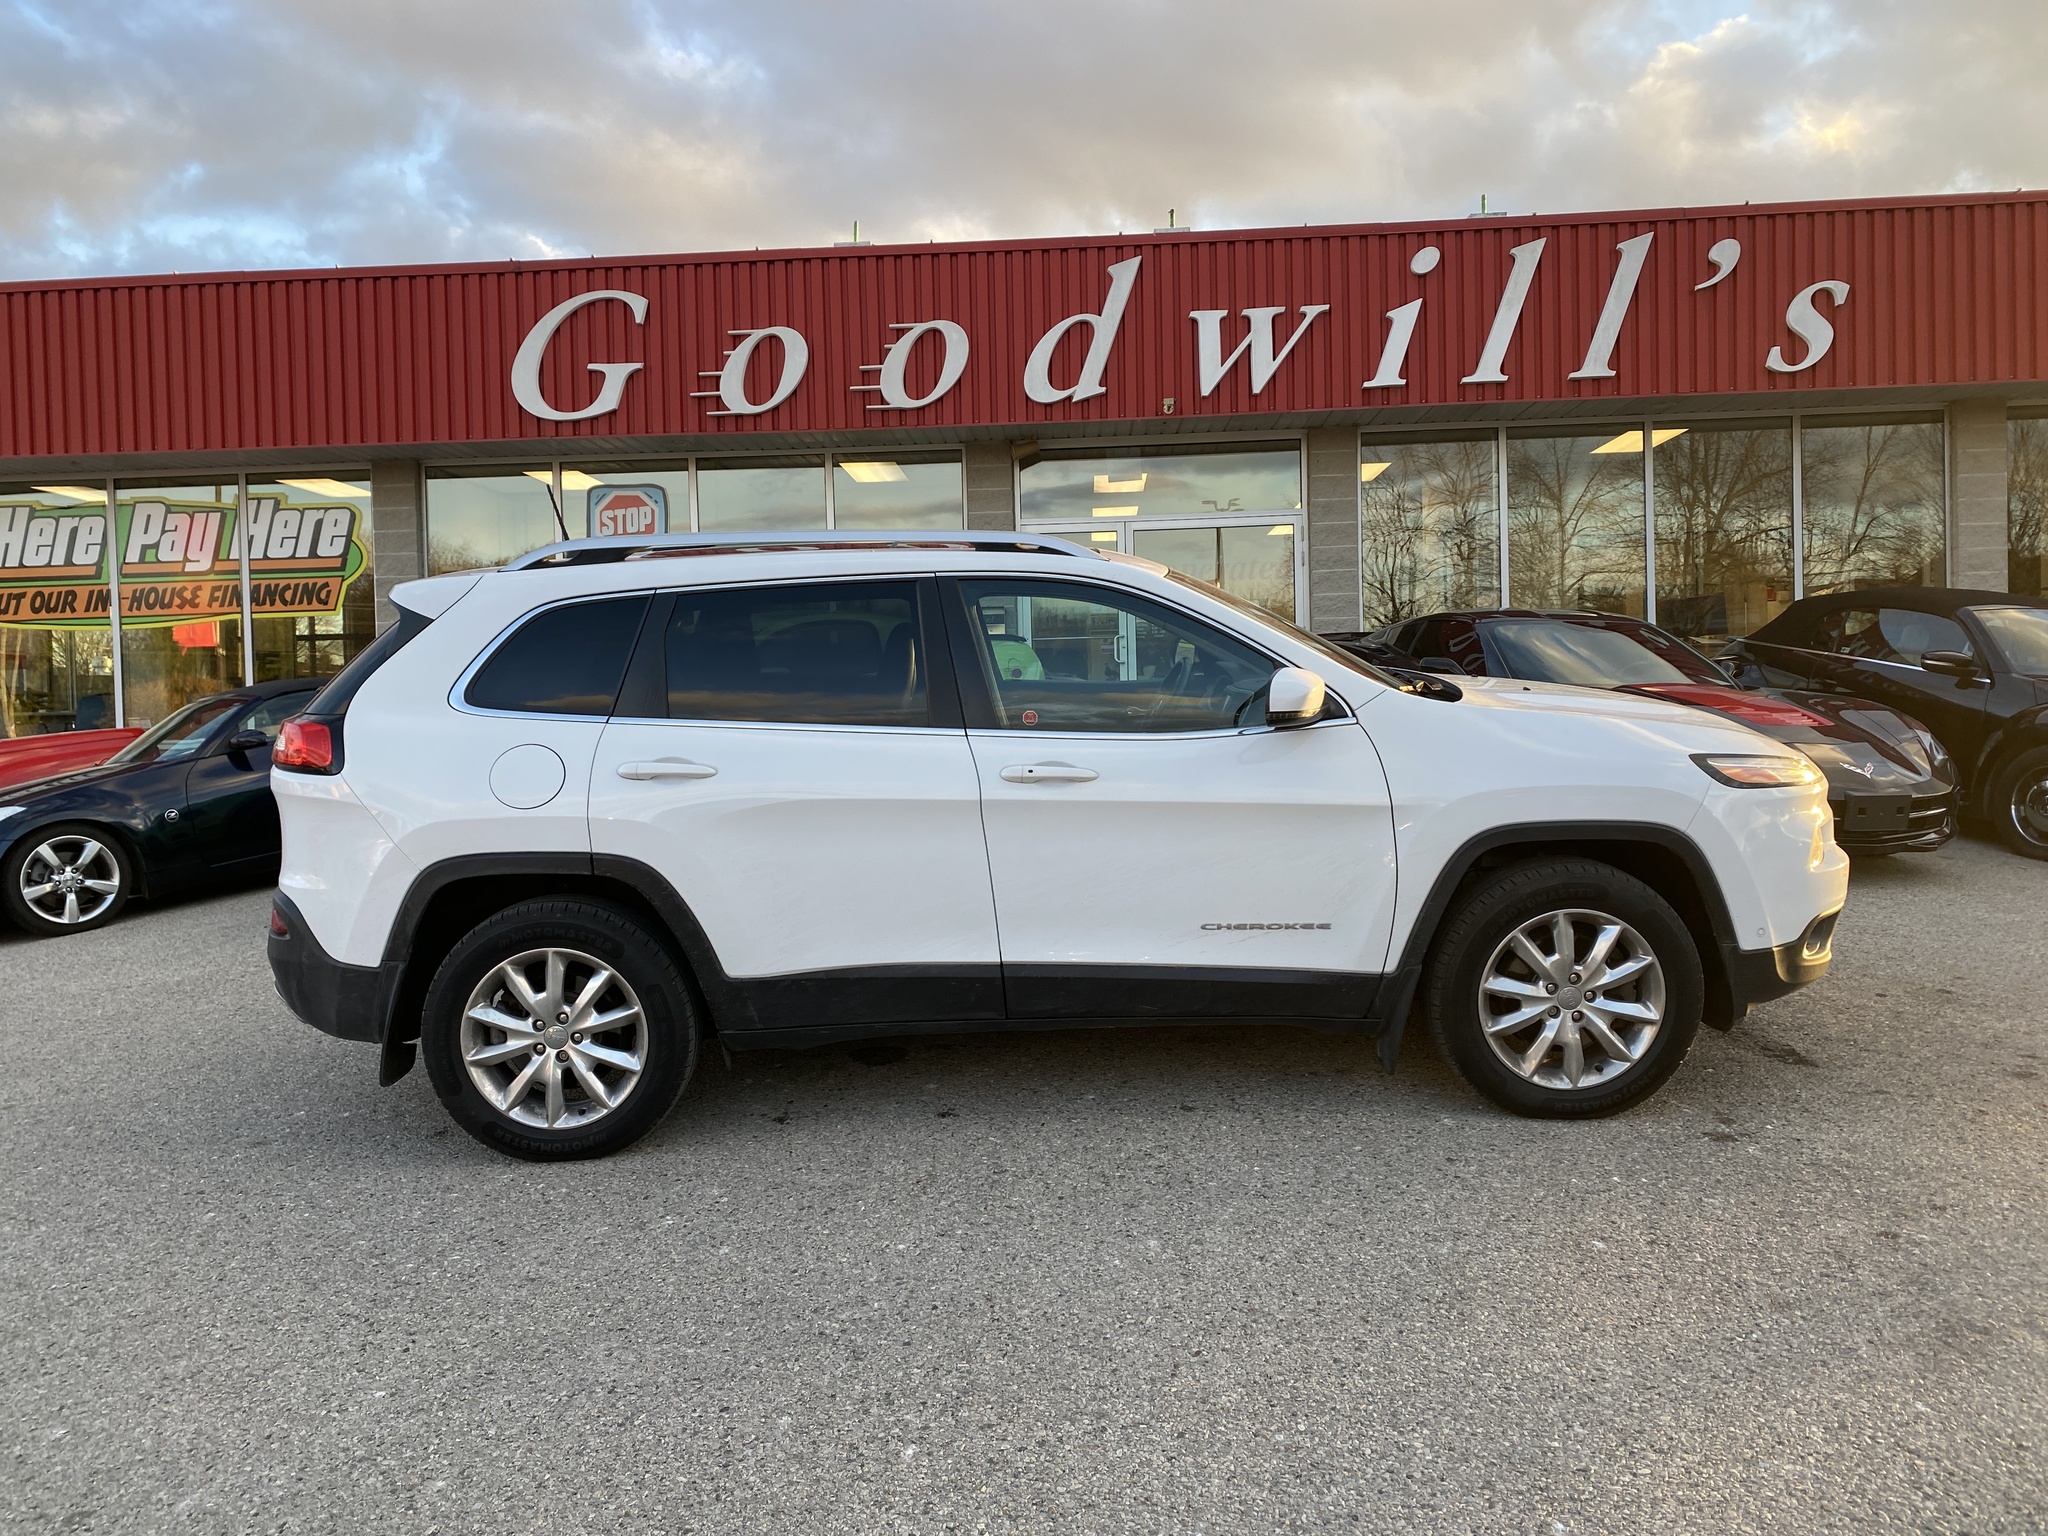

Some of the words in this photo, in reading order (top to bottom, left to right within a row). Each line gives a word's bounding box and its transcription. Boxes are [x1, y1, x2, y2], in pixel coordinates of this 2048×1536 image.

[511, 230, 1849, 421] Goodwill's
[0, 506, 105, 567] Here
[125, 502, 221, 572] Pay
[228, 498, 350, 560] Here
[601, 506, 652, 536] STOP
[30, 588, 78, 614] OUR
[207, 582, 332, 608] FINANCING
[1200, 923, 1332, 931] CHEROKEE
